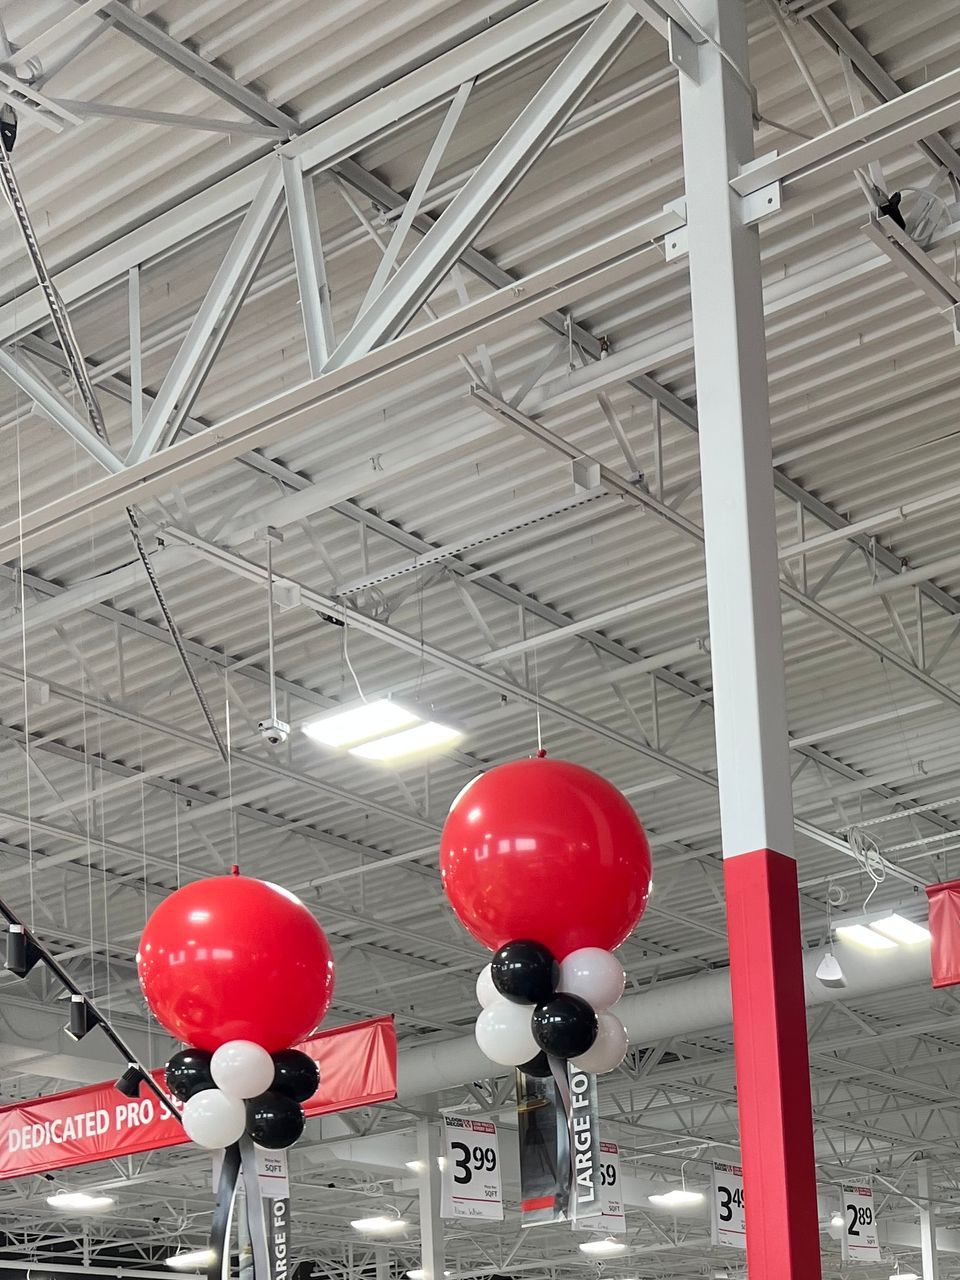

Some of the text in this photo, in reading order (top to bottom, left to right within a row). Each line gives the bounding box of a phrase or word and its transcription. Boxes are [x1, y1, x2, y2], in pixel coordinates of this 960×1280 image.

[570, 1074, 590, 1109] FO
[8, 1109, 110, 1153] DEDICATED
[115, 1098, 155, 1131] PRO
[265, 1164, 282, 1173] SQFT
[574, 1115, 595, 1203] LARGE
[273, 1198, 287, 1227] FO
[846, 1204, 873, 1237] 289
